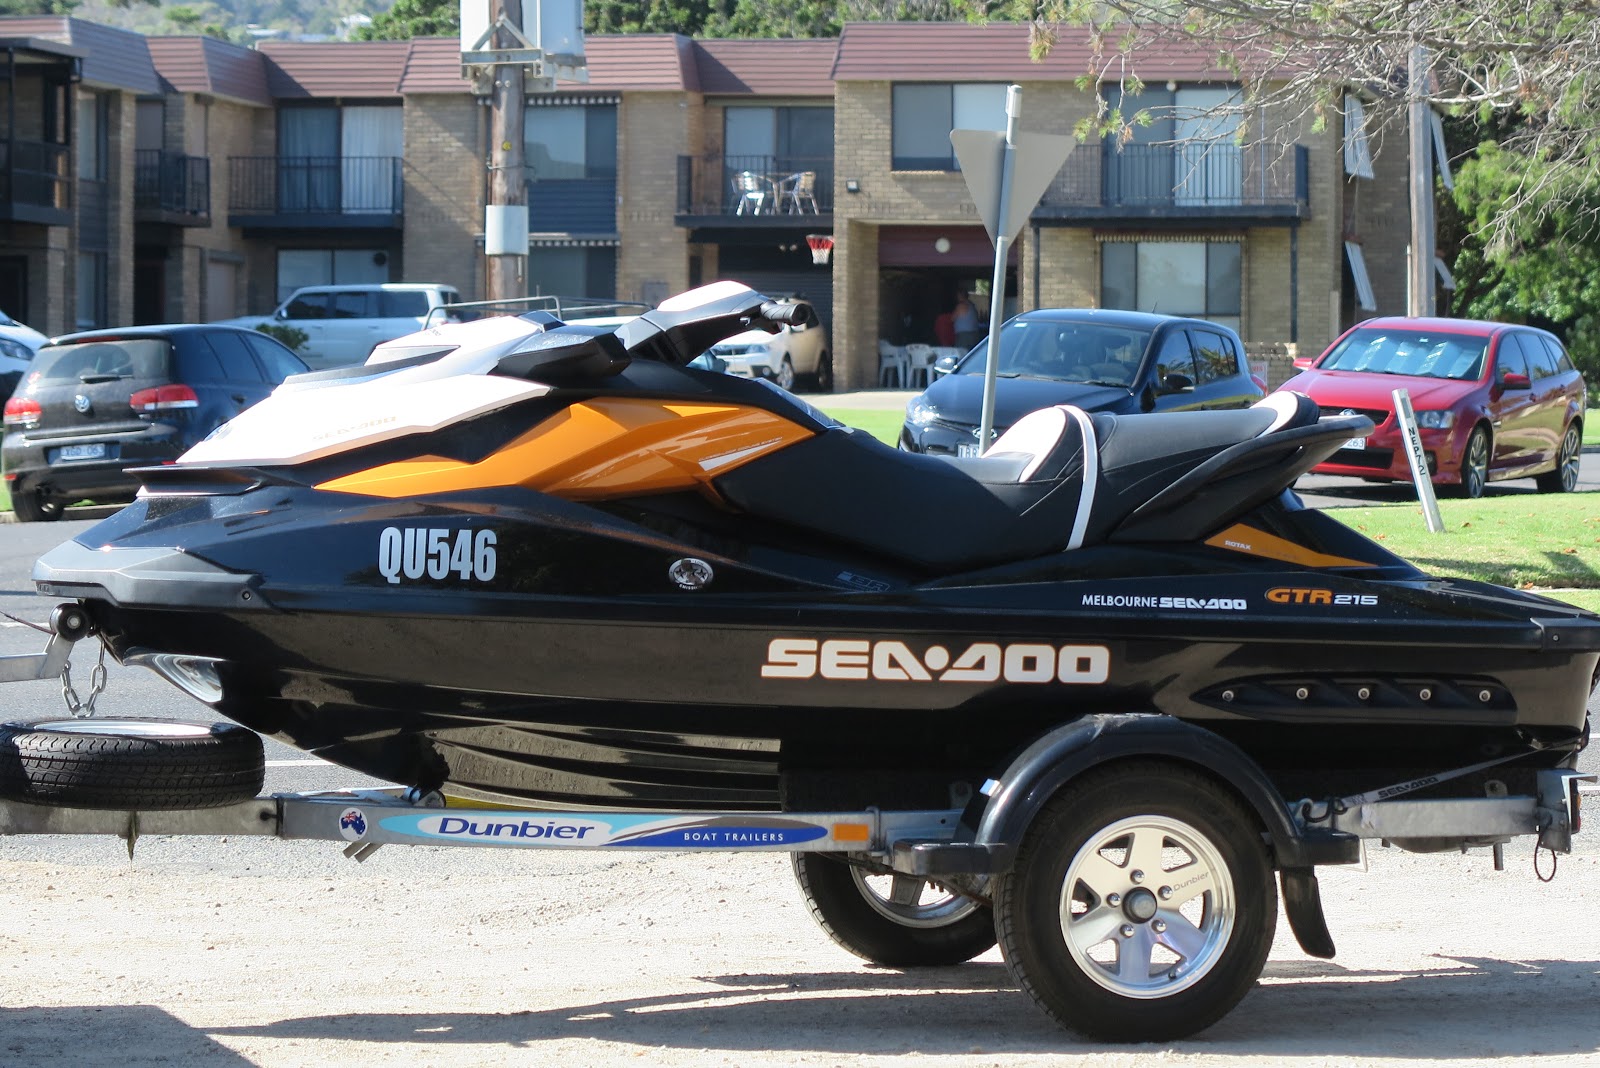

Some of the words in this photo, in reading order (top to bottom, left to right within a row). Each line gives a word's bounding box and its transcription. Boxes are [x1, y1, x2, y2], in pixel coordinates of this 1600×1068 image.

[1225, 540, 1251, 550] ROTAX
[378, 526, 497, 584] QU546
[1082, 594, 1157, 608] MELBOURNE
[1265, 587, 1333, 605] GTR
[1334, 594, 1379, 606] 215
[440, 817, 595, 840] Dunbier
[684, 832, 716, 841] BOAT
[724, 832, 784, 841] TRAILERS
[1174, 871, 1209, 891] Dunbier
